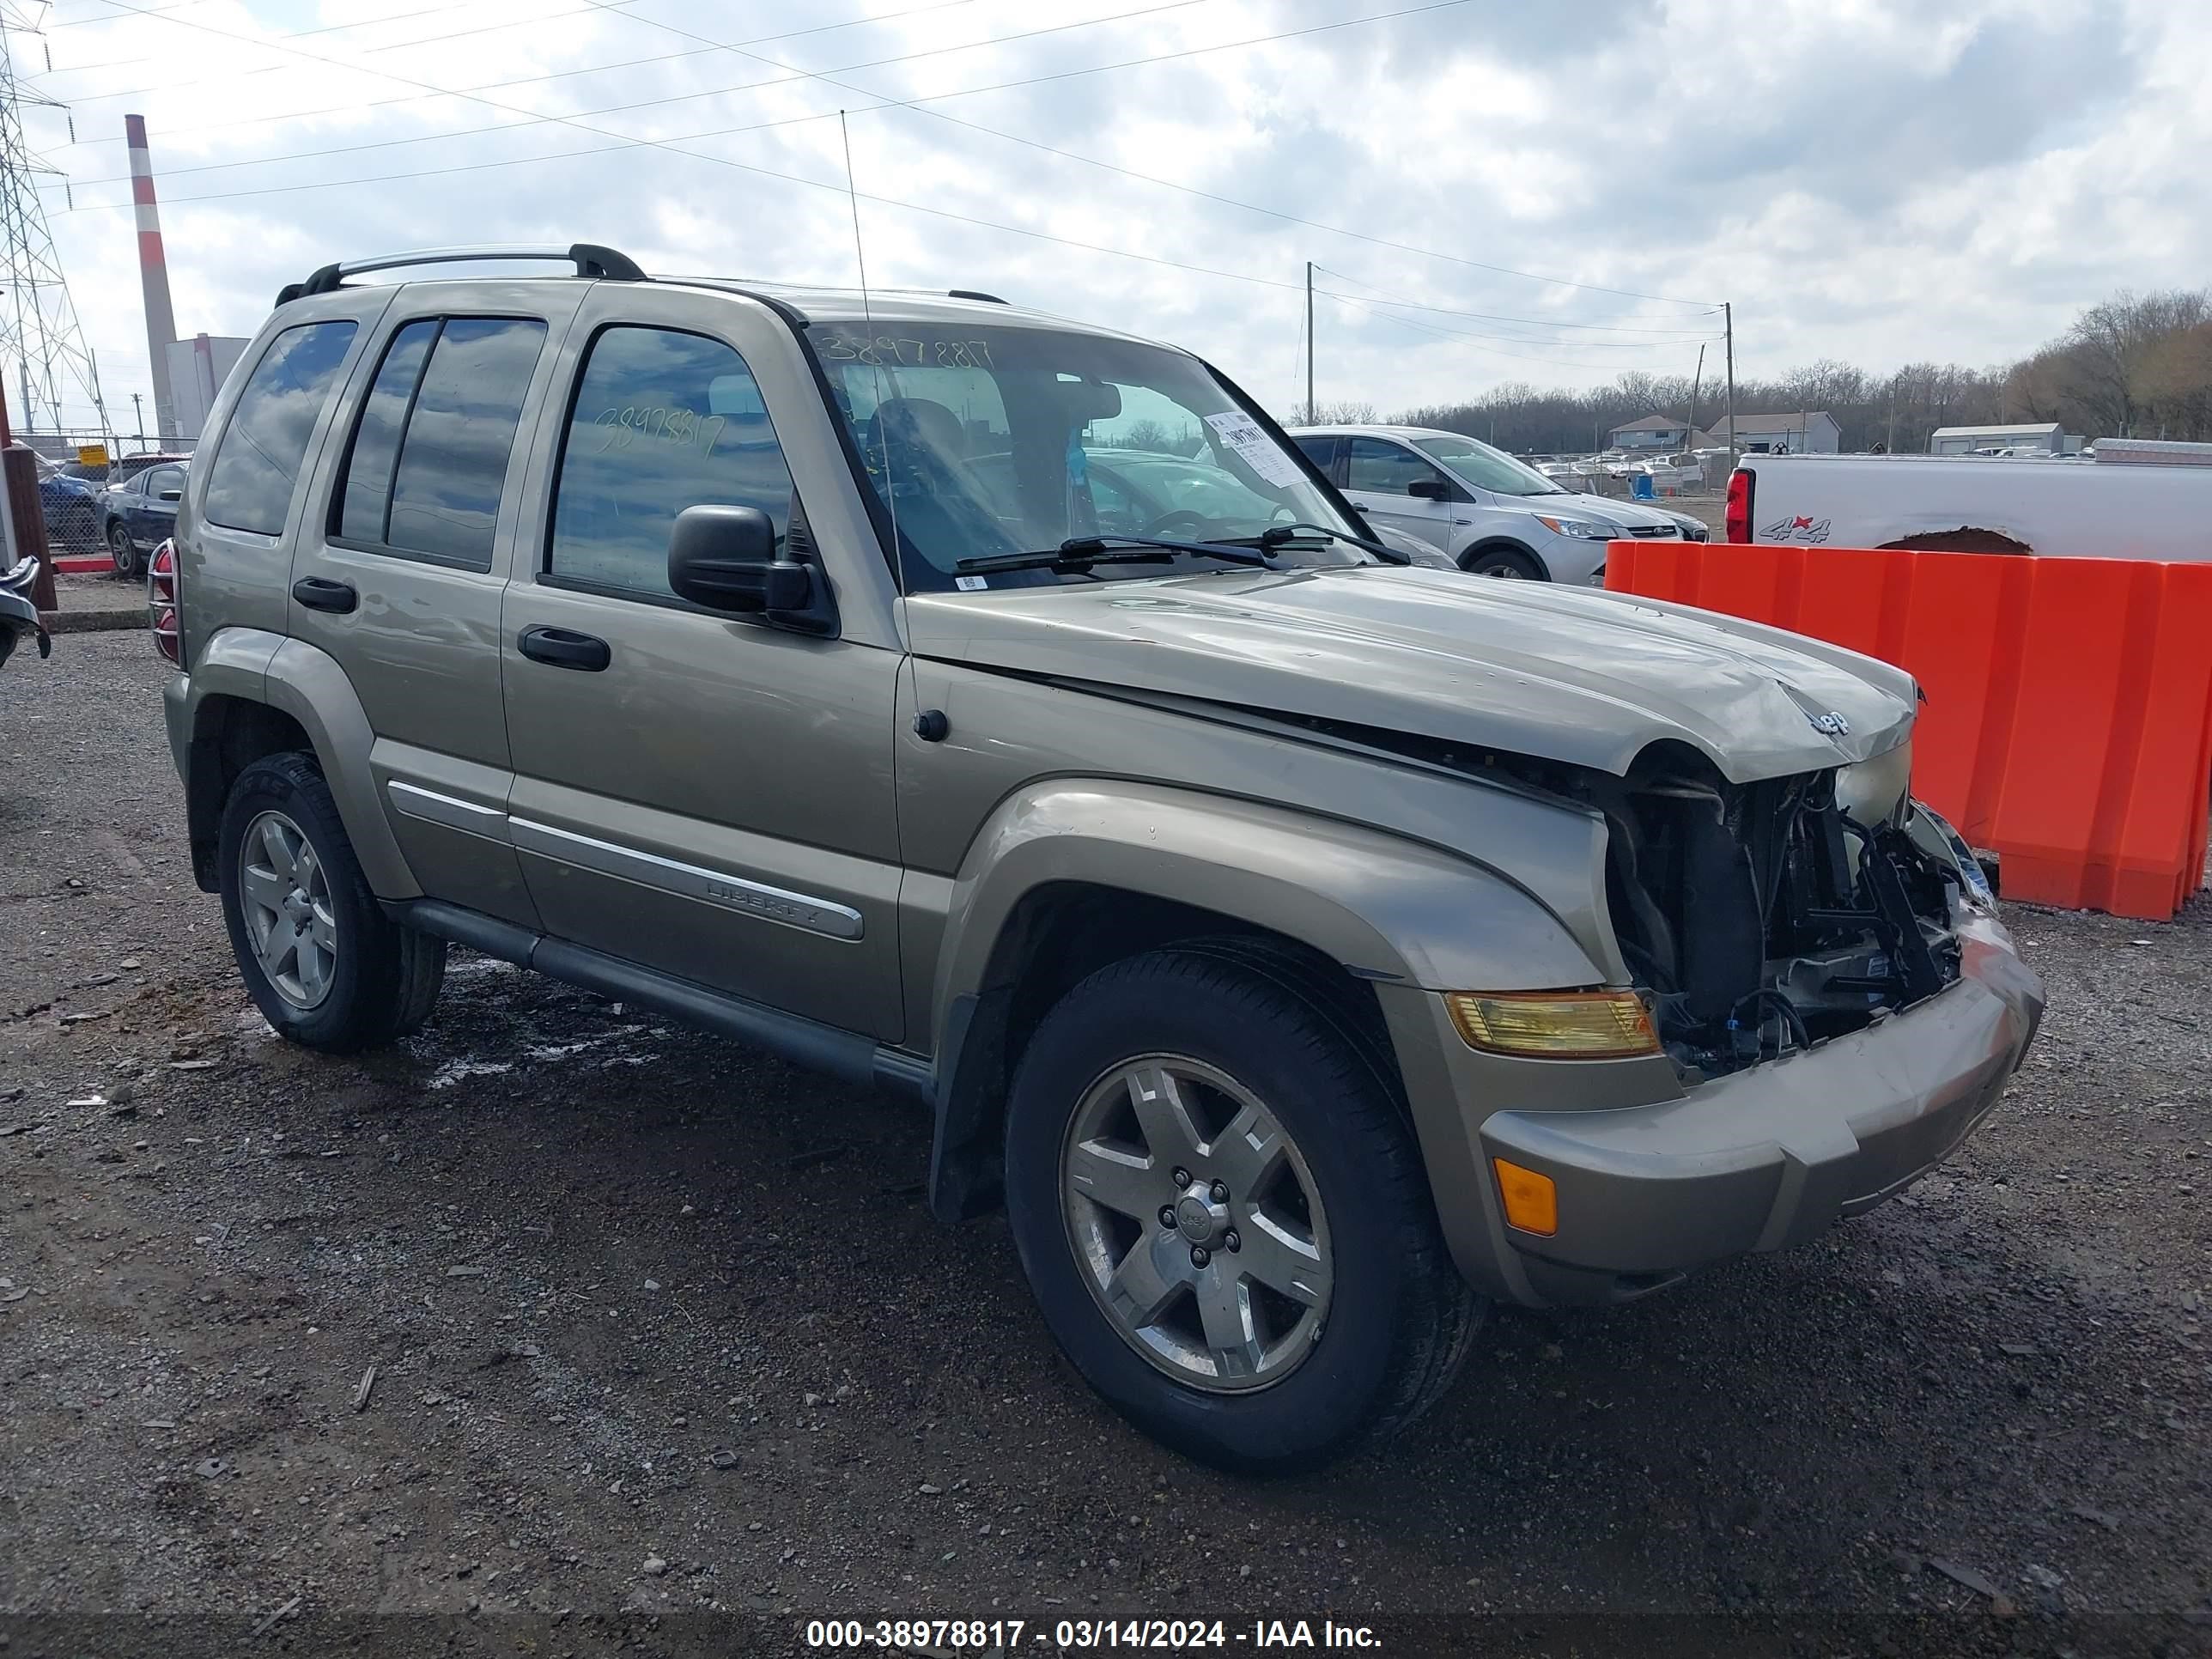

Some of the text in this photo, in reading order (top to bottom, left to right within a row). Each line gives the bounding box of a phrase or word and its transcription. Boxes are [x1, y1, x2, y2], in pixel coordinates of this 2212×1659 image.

[817, 336, 995, 370] 38978817
[594, 406, 726, 460] 38978817
[707, 883, 822, 923] LIBERTY
